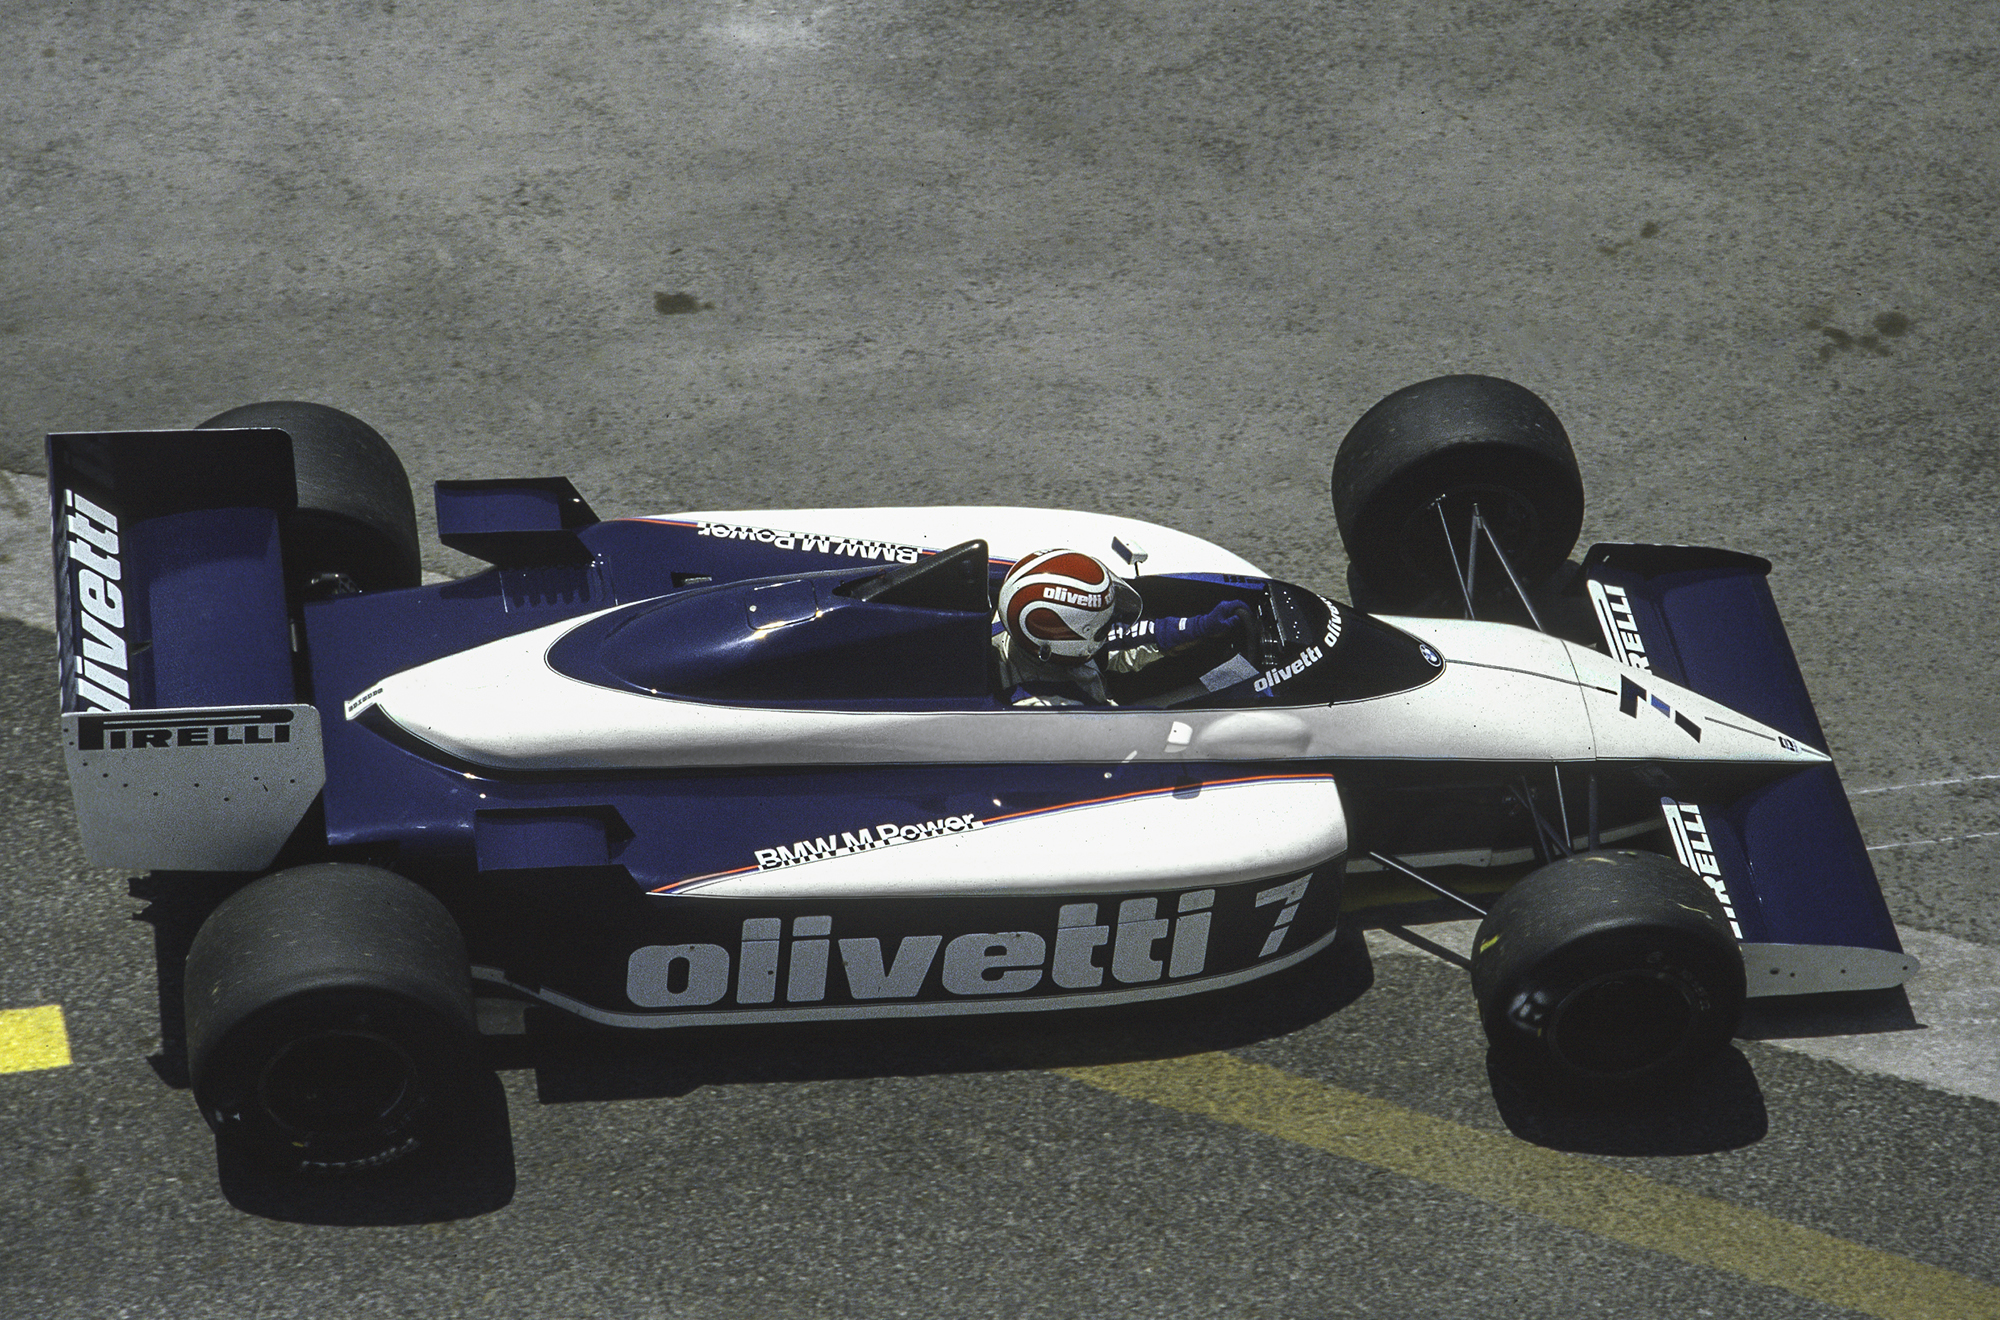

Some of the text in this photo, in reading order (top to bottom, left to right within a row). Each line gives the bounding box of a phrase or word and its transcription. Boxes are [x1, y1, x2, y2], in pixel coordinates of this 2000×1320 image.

[697, 522, 919, 564] BMW M Power
[65, 488, 131, 714] livetti
[1042, 586, 1102, 608] olivetti
[1586, 579, 1653, 676] RELLI
[1253, 646, 1323, 692] olivetti
[77, 708, 295, 751] PIRELLI
[1619, 673, 1702, 743] 7
[754, 813, 976, 871] BMW M Power
[625, 871, 1314, 1008] olivetti 7
